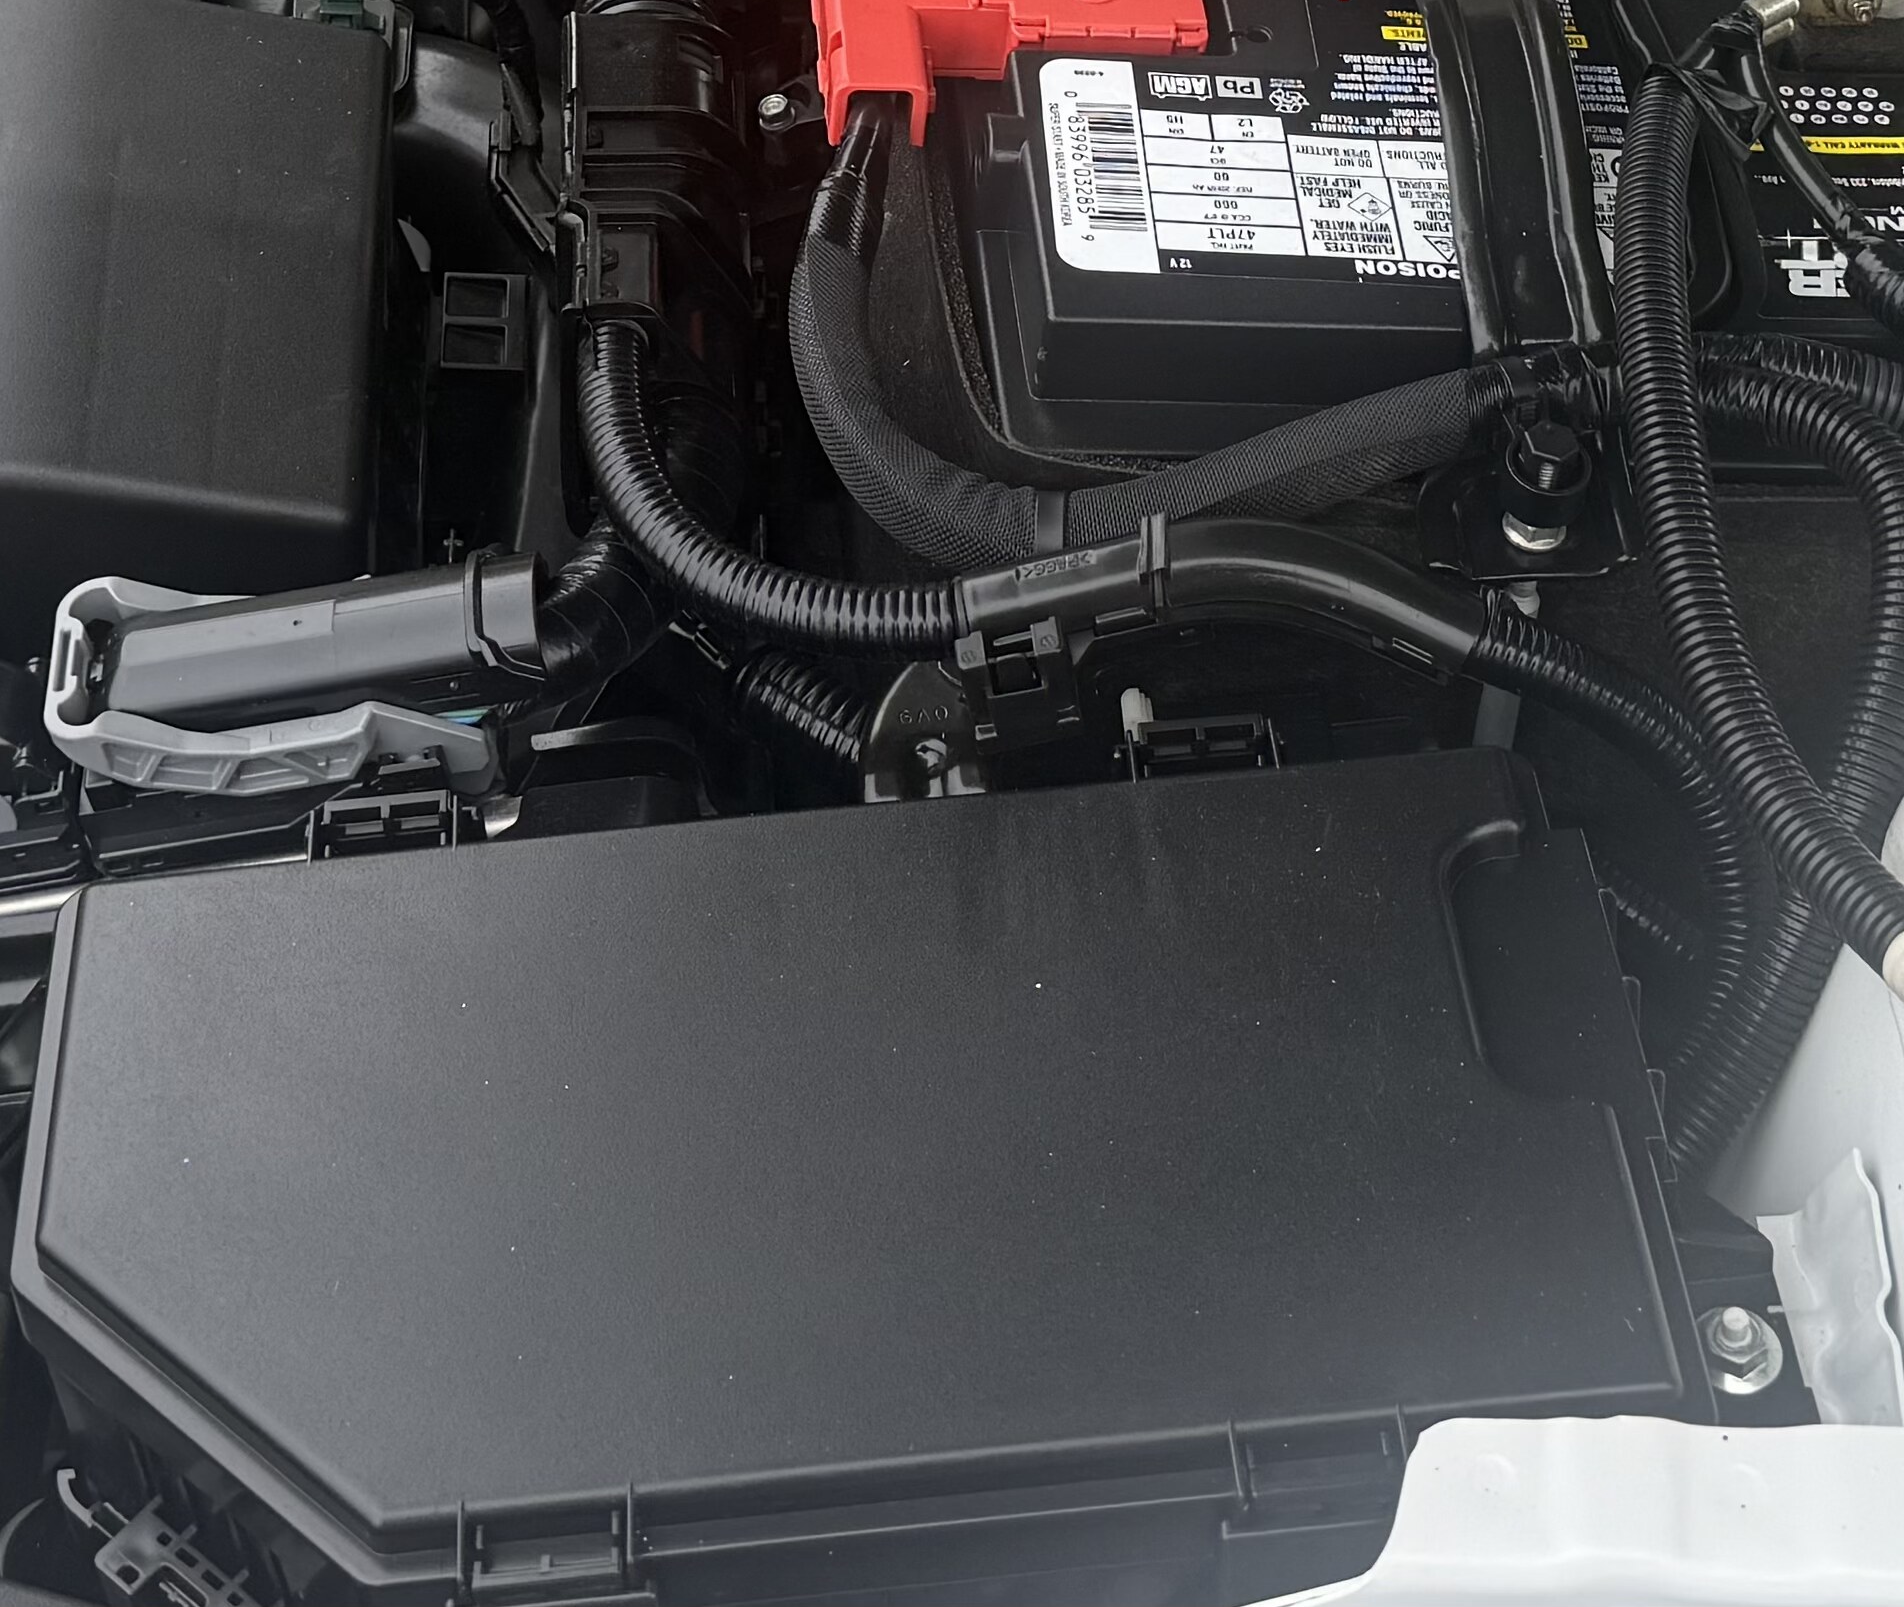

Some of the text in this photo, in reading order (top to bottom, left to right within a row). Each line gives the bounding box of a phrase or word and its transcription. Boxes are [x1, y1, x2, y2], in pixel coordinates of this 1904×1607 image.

[1152, 75, 1207, 94] AGM
[1223, 80, 1255, 94] Pb
[1068, 115, 1089, 162] 83996
[1210, 145, 1225, 154] 47
[1073, 168, 1095, 214] 03285
[1299, 186, 1353, 199] MEDICAL
[1310, 218, 1390, 233] WITH WATER.
[1081, 234, 1095, 242] 9
[1207, 227, 1256, 240] 47PLT
[1312, 231, 1392, 244] IMMEDIATELY
[1323, 242, 1354, 253] EYES
[1178, 258, 1192, 268] 12
